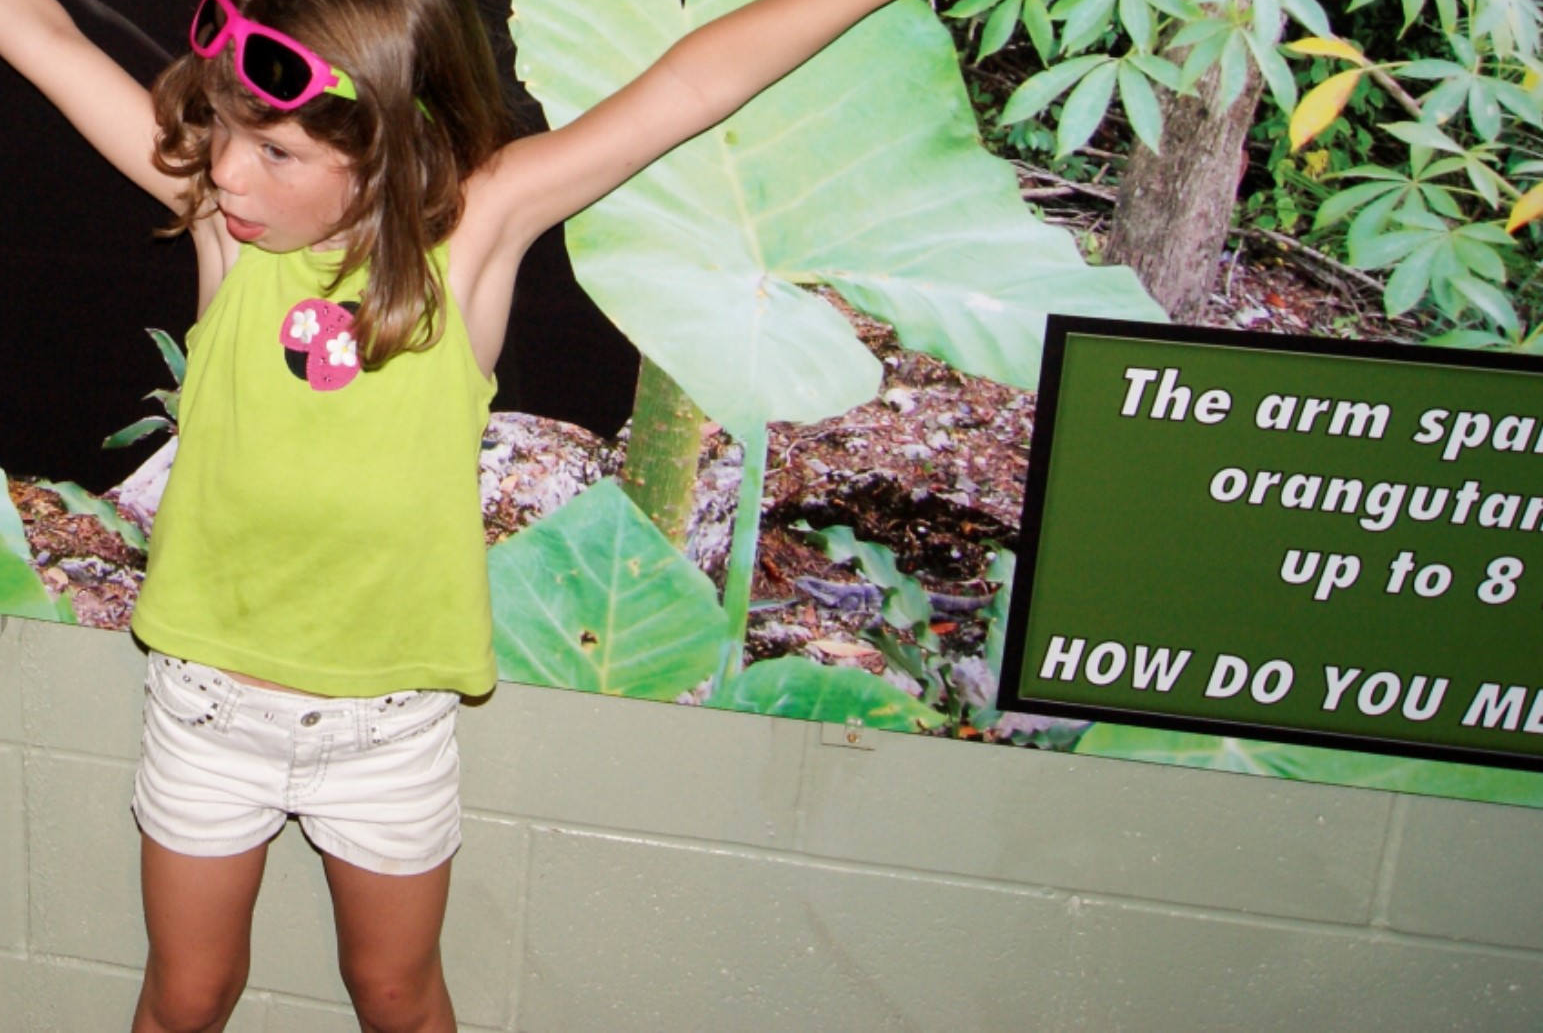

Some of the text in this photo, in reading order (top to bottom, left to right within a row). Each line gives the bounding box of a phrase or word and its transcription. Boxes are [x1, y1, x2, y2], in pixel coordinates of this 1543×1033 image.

[1121, 367, 1543, 461] The arm spa
[1281, 550, 1524, 604] up to 8
[1039, 636, 1192, 692] HOW
[1204, 654, 1294, 704] DO
[1323, 666, 1449, 721] YOU
